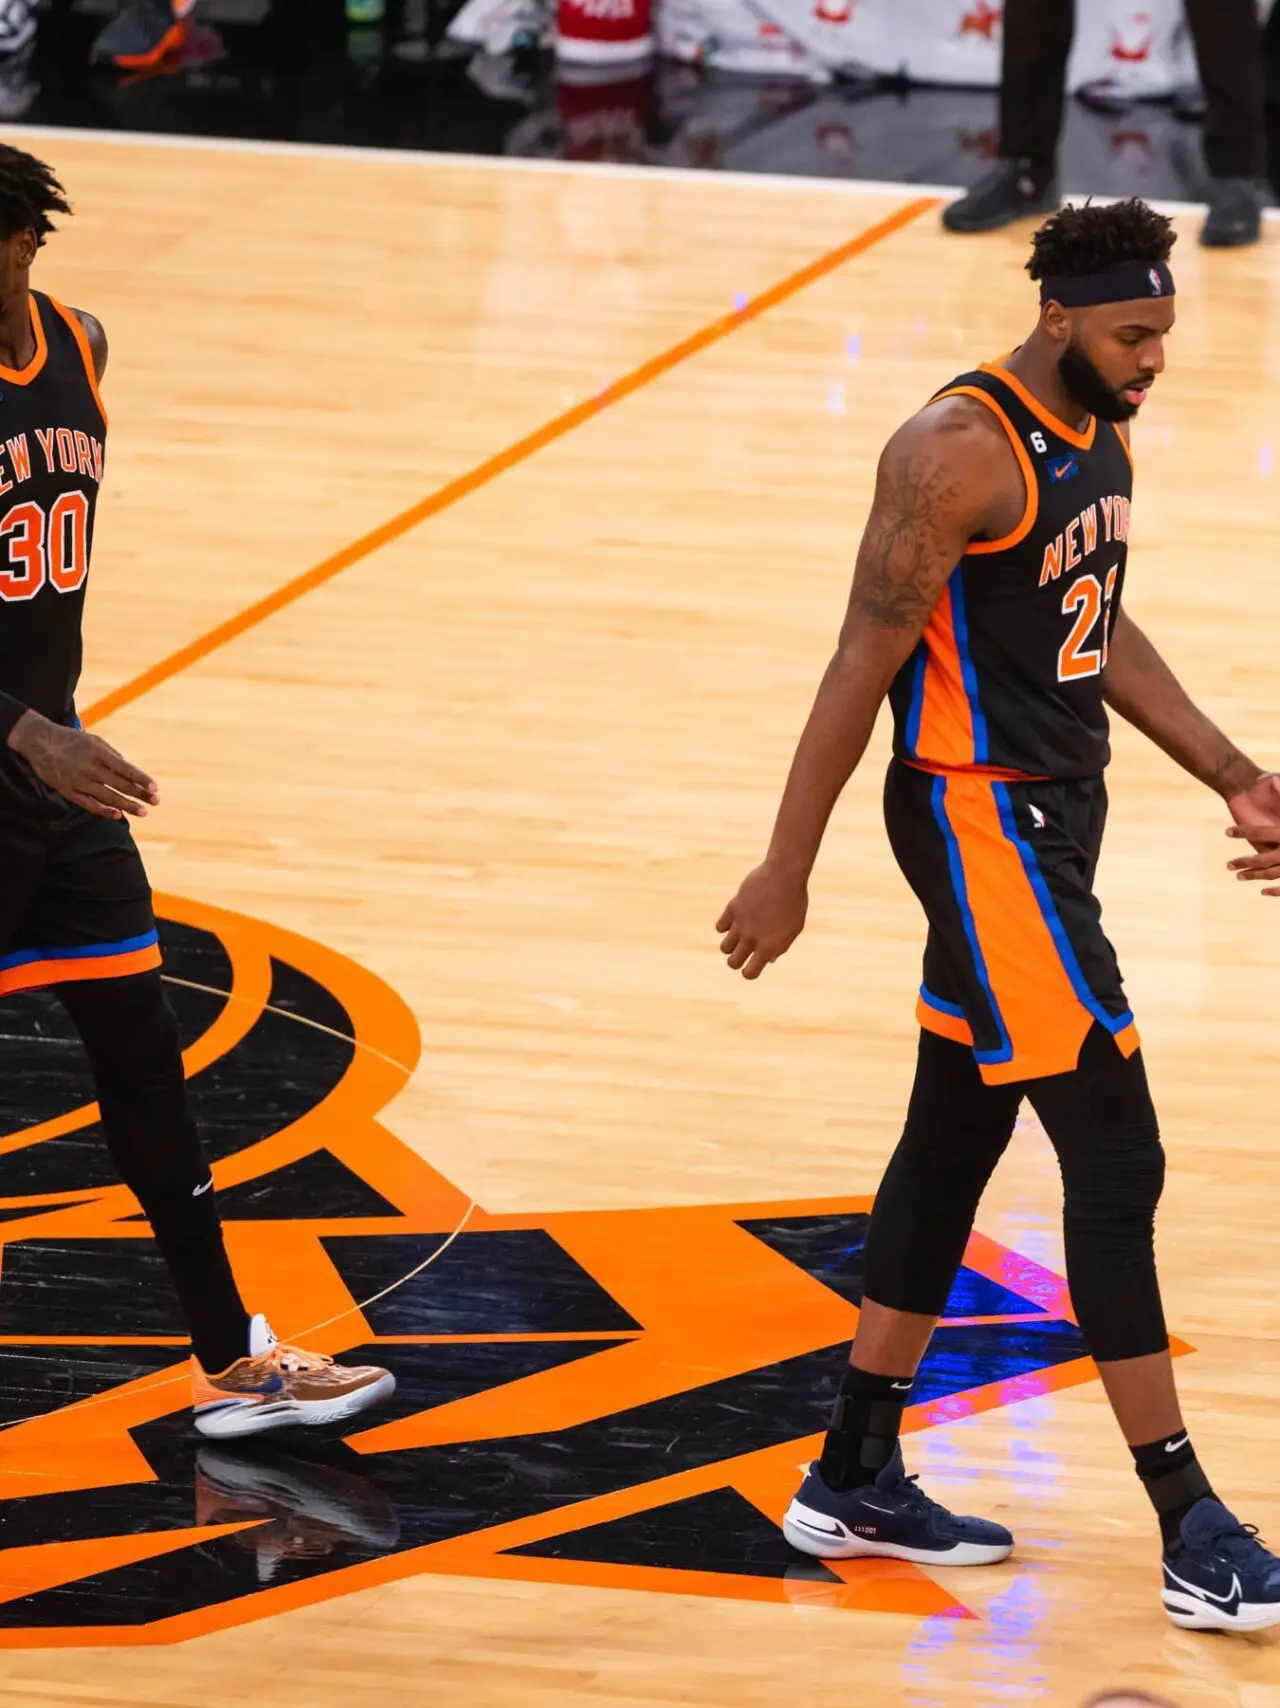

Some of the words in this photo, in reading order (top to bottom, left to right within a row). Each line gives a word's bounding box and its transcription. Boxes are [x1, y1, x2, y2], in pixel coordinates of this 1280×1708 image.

[35, 427, 104, 484] YORK
[1029, 430, 1048, 454] 6
[0, 489, 89, 602] 30
[1038, 503, 1097, 588] NEW
[1100, 494, 1132, 543] YOR
